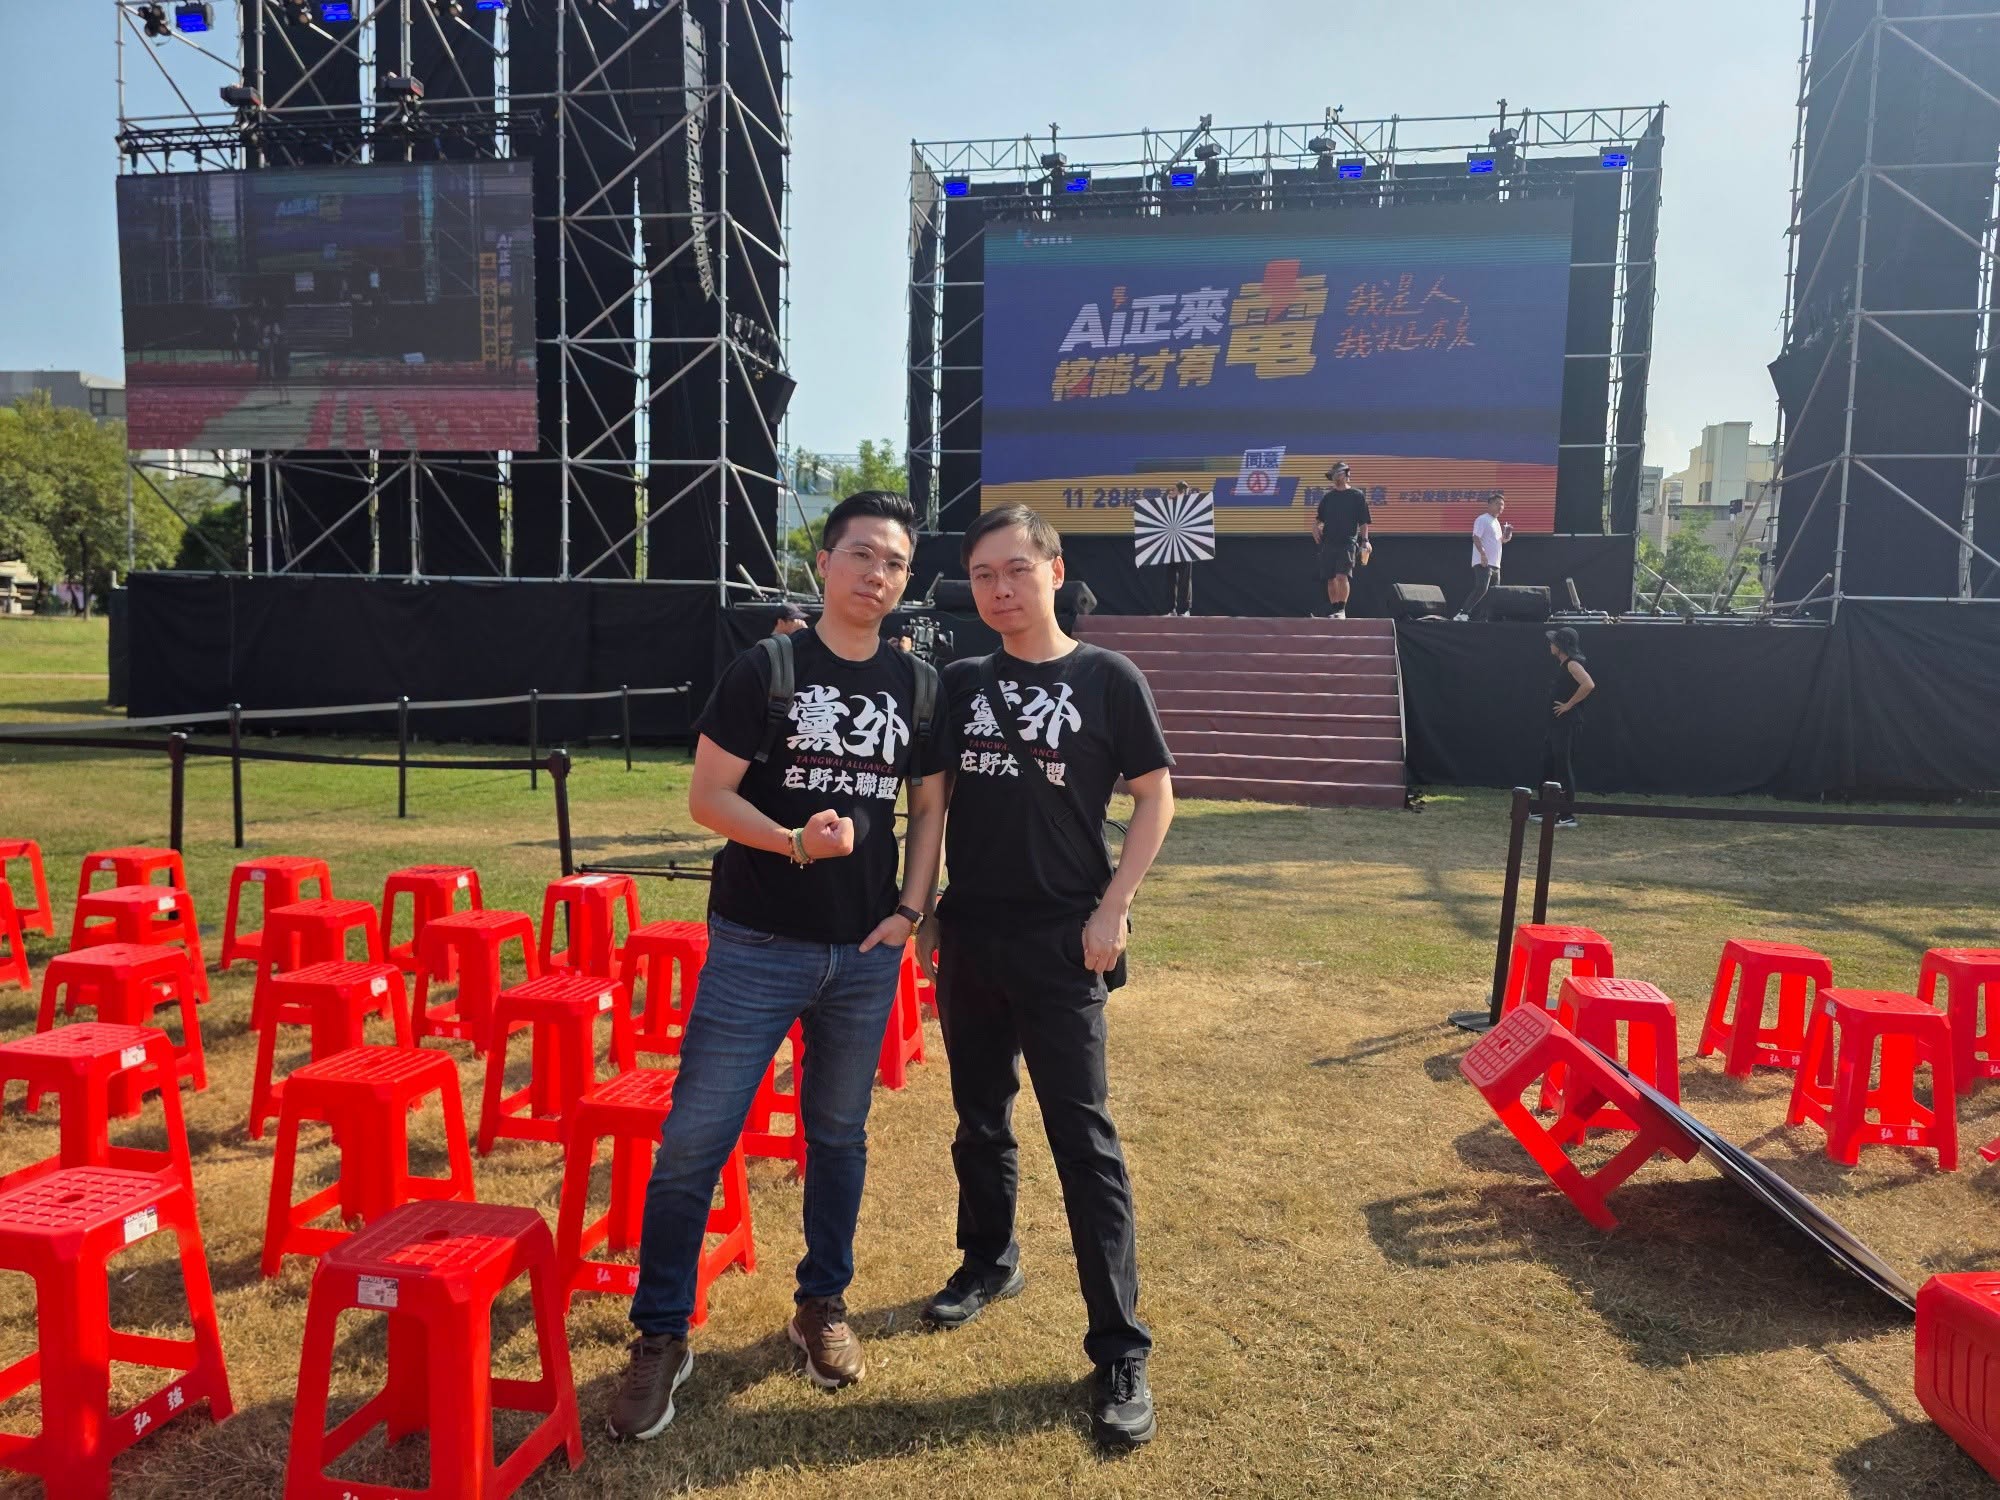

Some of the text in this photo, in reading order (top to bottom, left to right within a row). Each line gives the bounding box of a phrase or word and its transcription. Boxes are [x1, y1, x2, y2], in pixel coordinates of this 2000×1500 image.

[1245, 451, 1279, 469] 同意
[786, 684, 910, 765] 黨外
[969, 740, 1008, 752] TANGWA
[796, 755, 895, 774] TANGWAI ALLIANCE
[960, 749, 1066, 787] 在野大盟
[782, 764, 899, 800] 在野大聯盟
